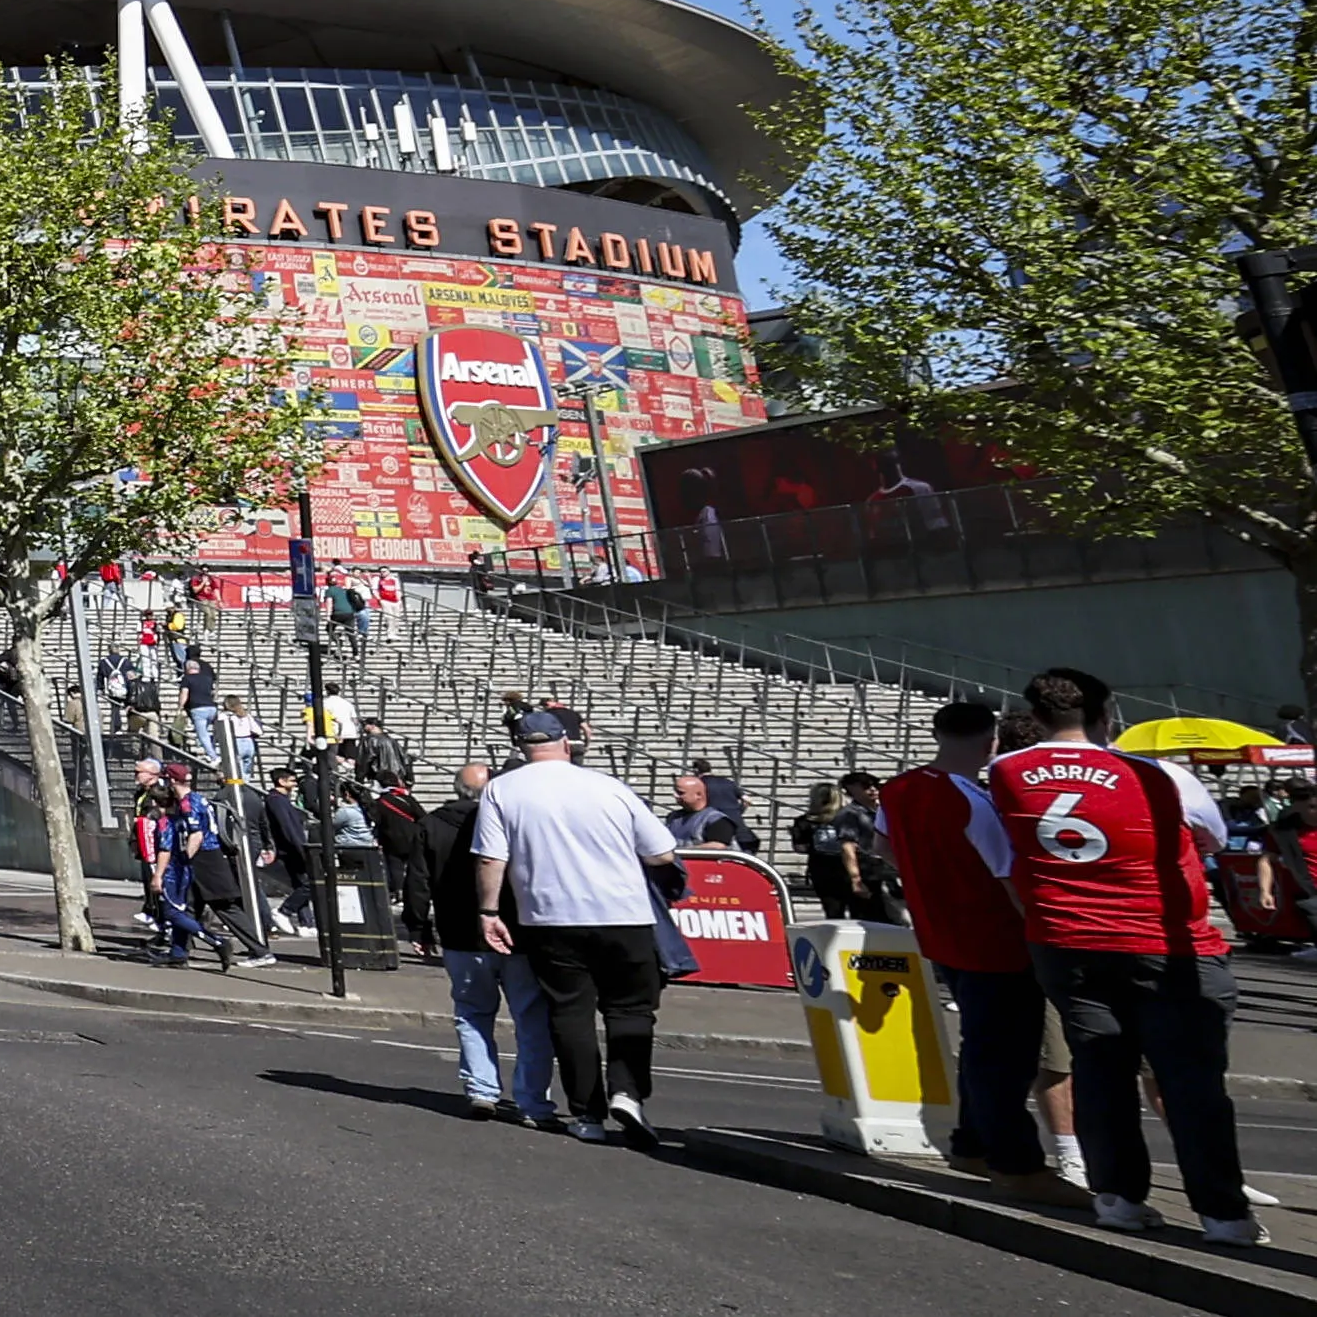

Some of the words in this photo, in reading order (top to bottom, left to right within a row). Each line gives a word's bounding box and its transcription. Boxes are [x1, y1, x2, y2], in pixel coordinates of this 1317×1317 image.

[78, 191, 440, 247] IRATES
[488, 217, 718, 284] STADIUM
[343, 281, 422, 306] Arsenal
[429, 287, 474, 304] ARSENAL
[441, 352, 538, 387] Arsenal
[312, 536, 354, 559] SENAL
[370, 538, 423, 561] GEORGIA
[1020, 764, 1120, 790] GABRIEL
[1035, 792, 1108, 864] 6
[668, 908, 769, 941] OMEN
